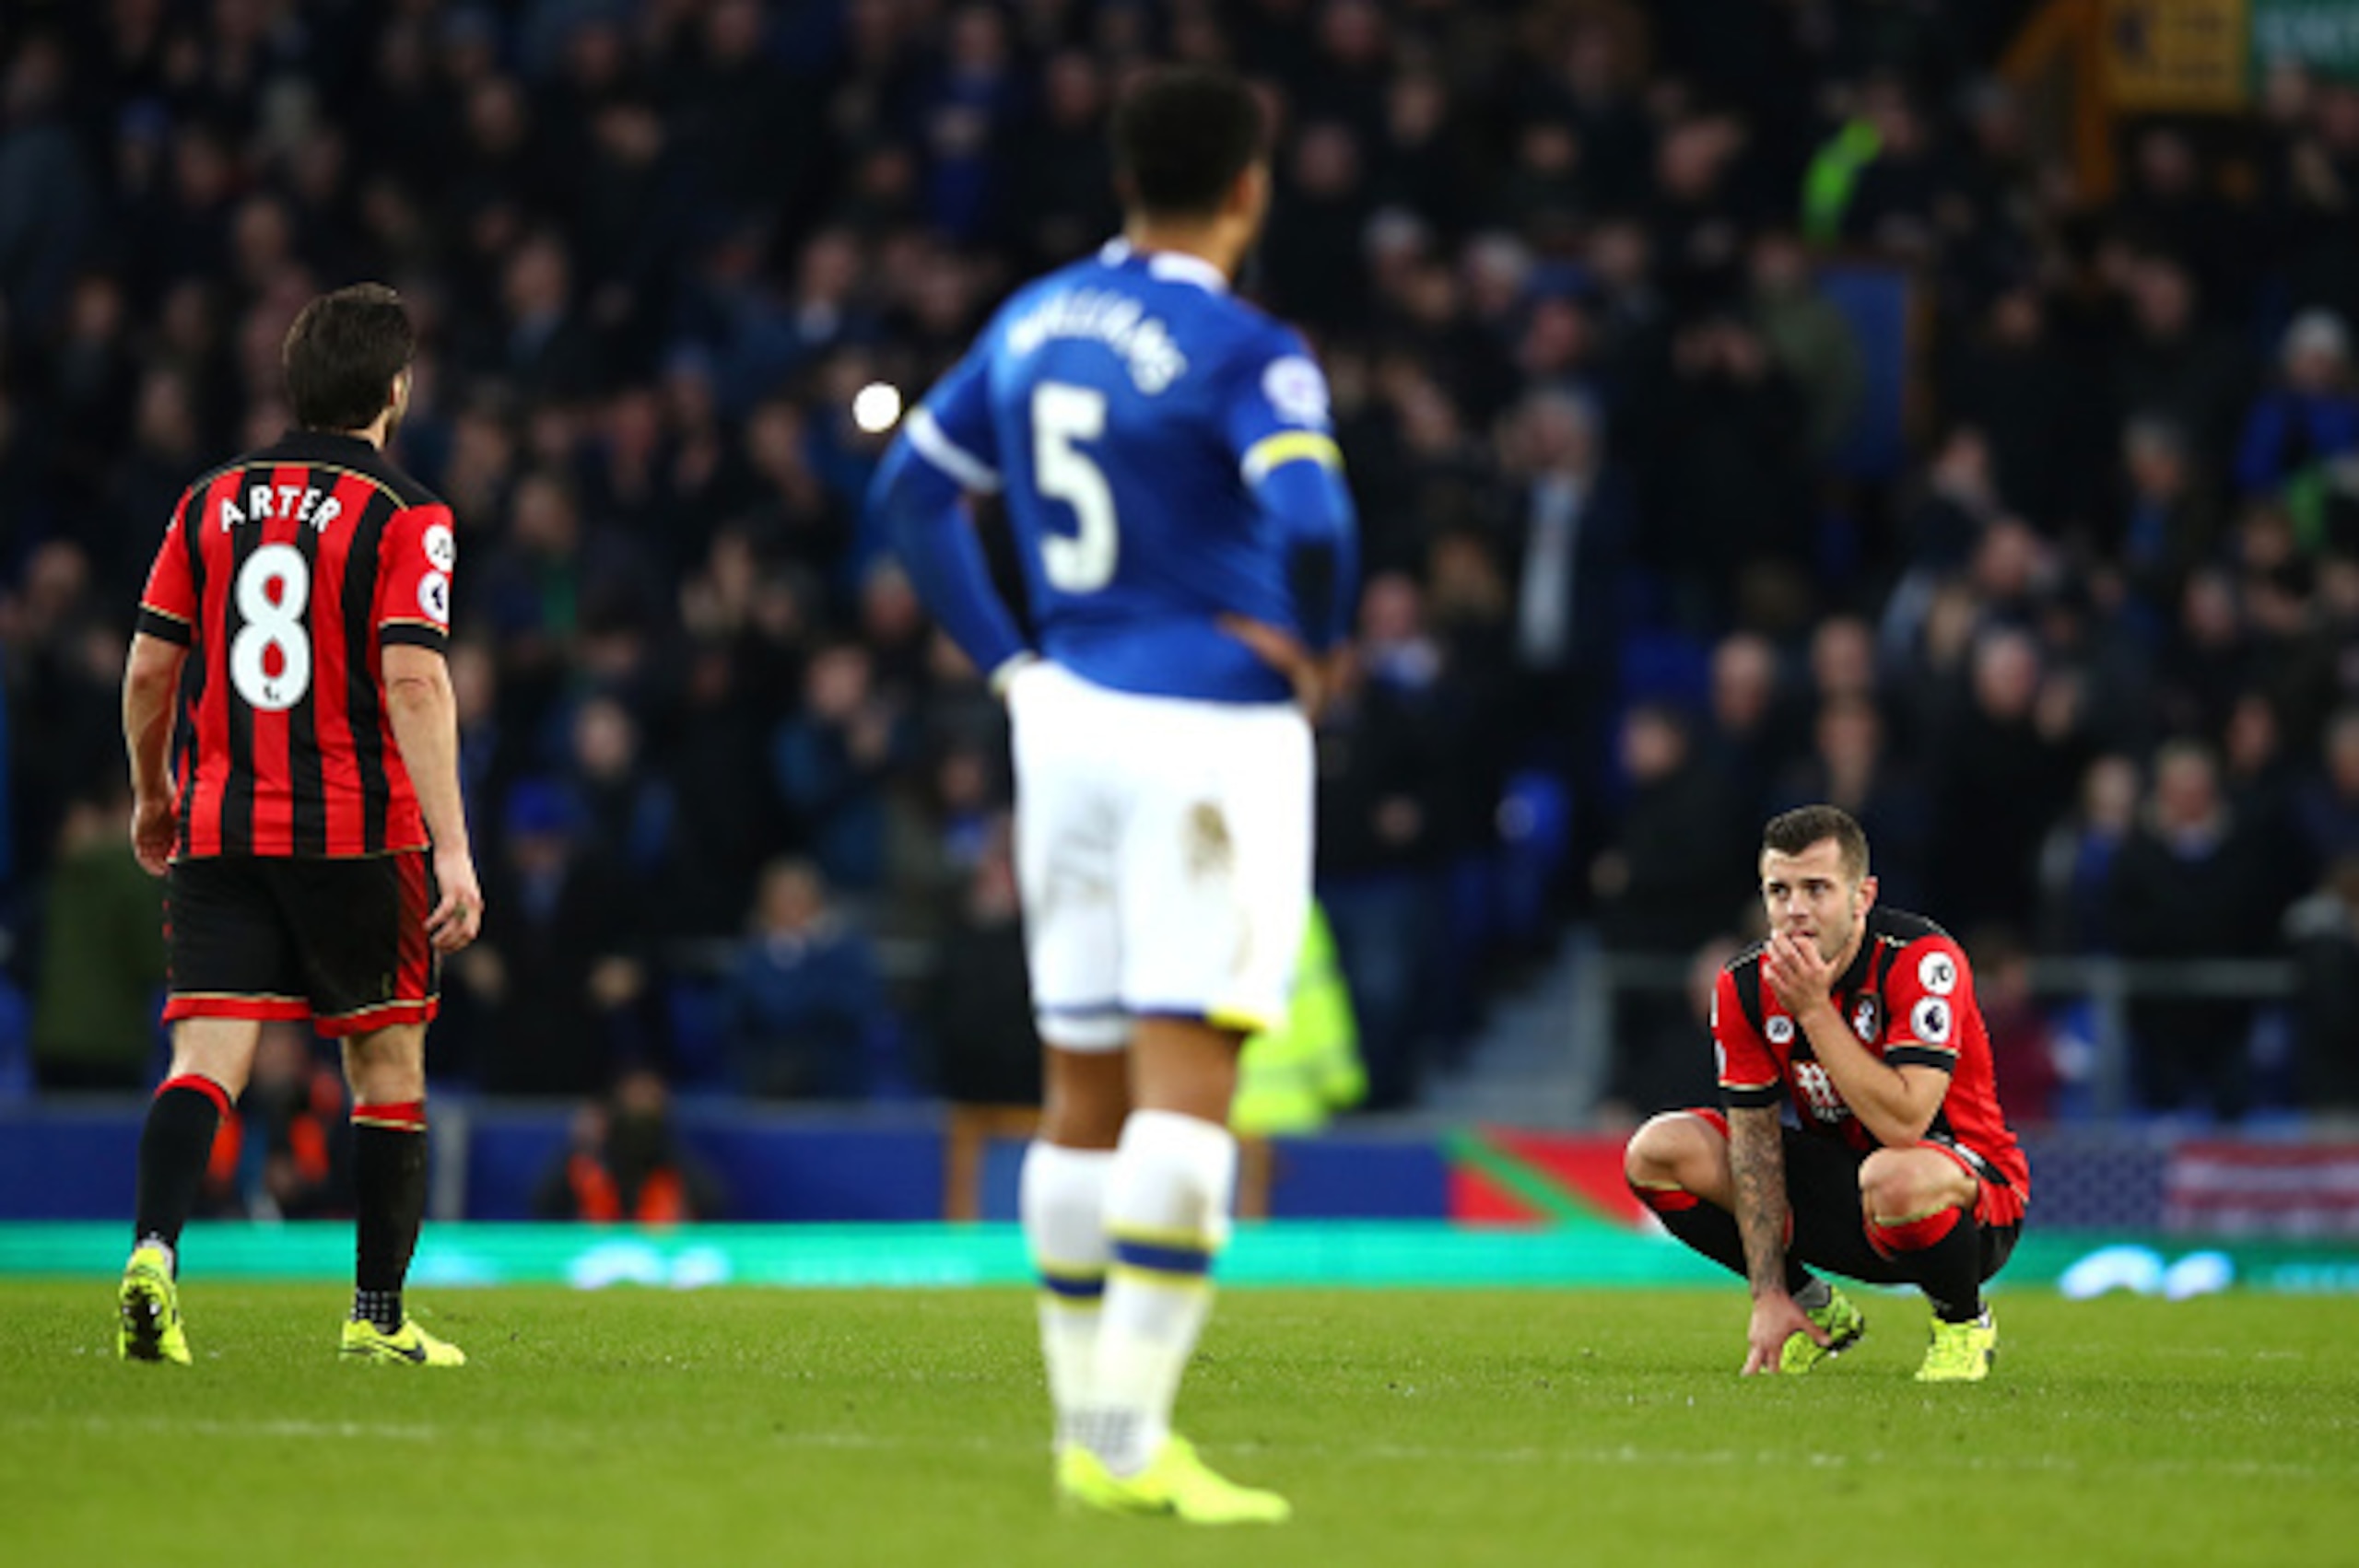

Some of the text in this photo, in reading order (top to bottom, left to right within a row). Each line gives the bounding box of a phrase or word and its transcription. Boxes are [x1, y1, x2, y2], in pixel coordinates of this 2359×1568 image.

[220, 485, 342, 533] ARTER
[1031, 380, 1119, 594] 5
[229, 542, 311, 711] 8
